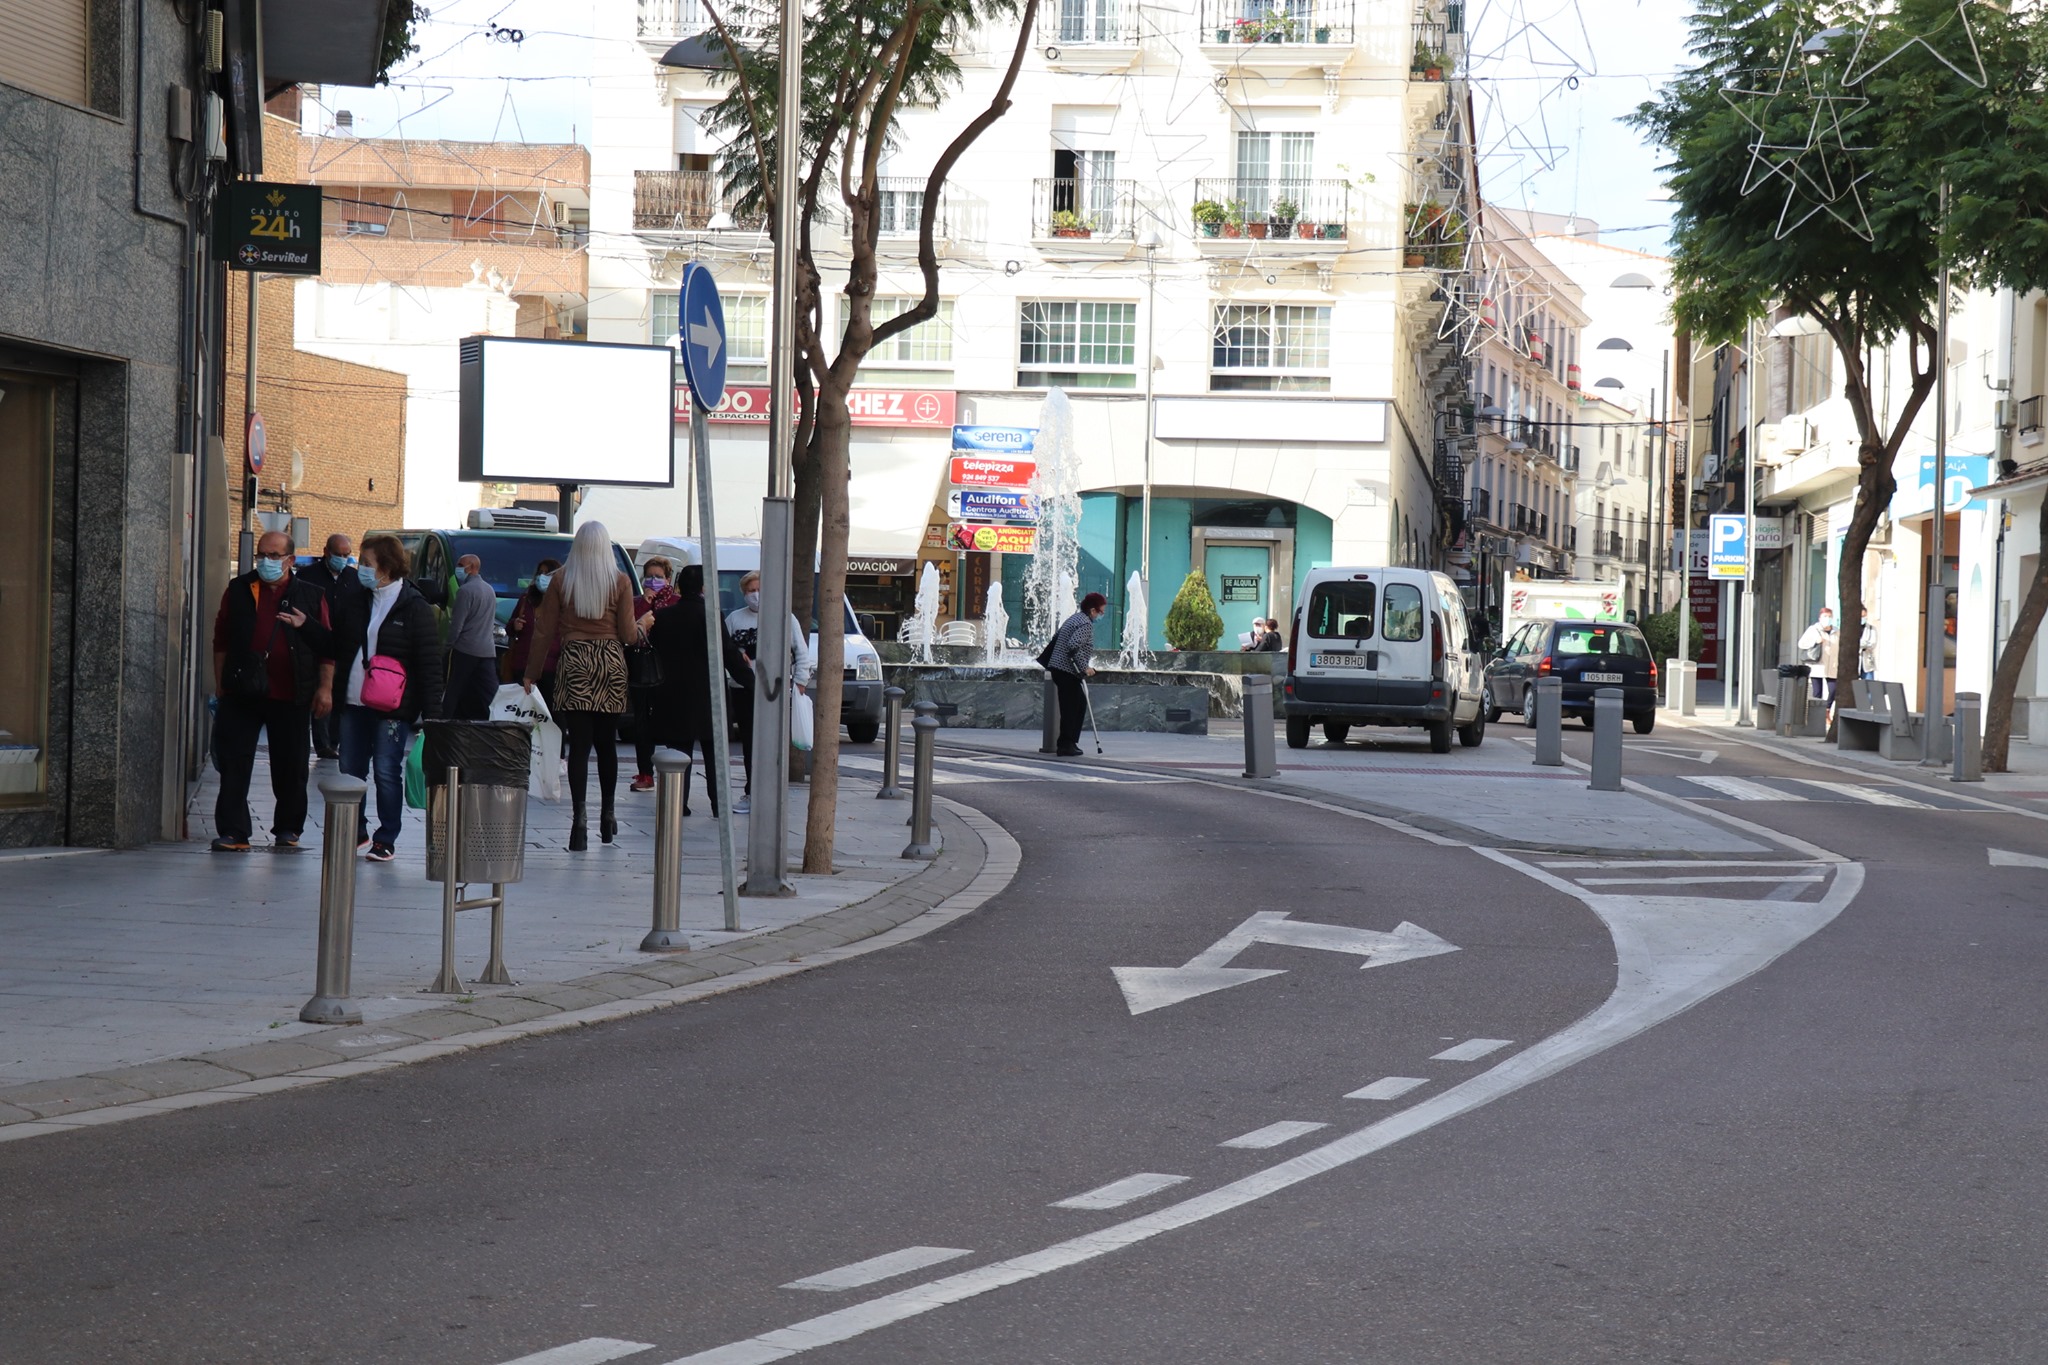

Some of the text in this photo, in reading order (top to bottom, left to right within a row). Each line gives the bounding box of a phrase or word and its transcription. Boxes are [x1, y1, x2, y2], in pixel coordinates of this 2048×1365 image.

[250, 208, 300, 218] CAJERO
[250, 214, 301, 241] 24h
[261, 251, 308, 264] ServiRed
[974, 430, 1023, 443] serena
[963, 460, 1015, 474] telepizza
[966, 494, 1017, 506] Audifon
[965, 506, 997, 514] Centros
[1713, 519, 1744, 553] P
[1713, 555, 1745, 563] PARKIN
[1316, 655, 1364, 666] 3803 BHD
[1586, 673, 1605, 681] 1051
